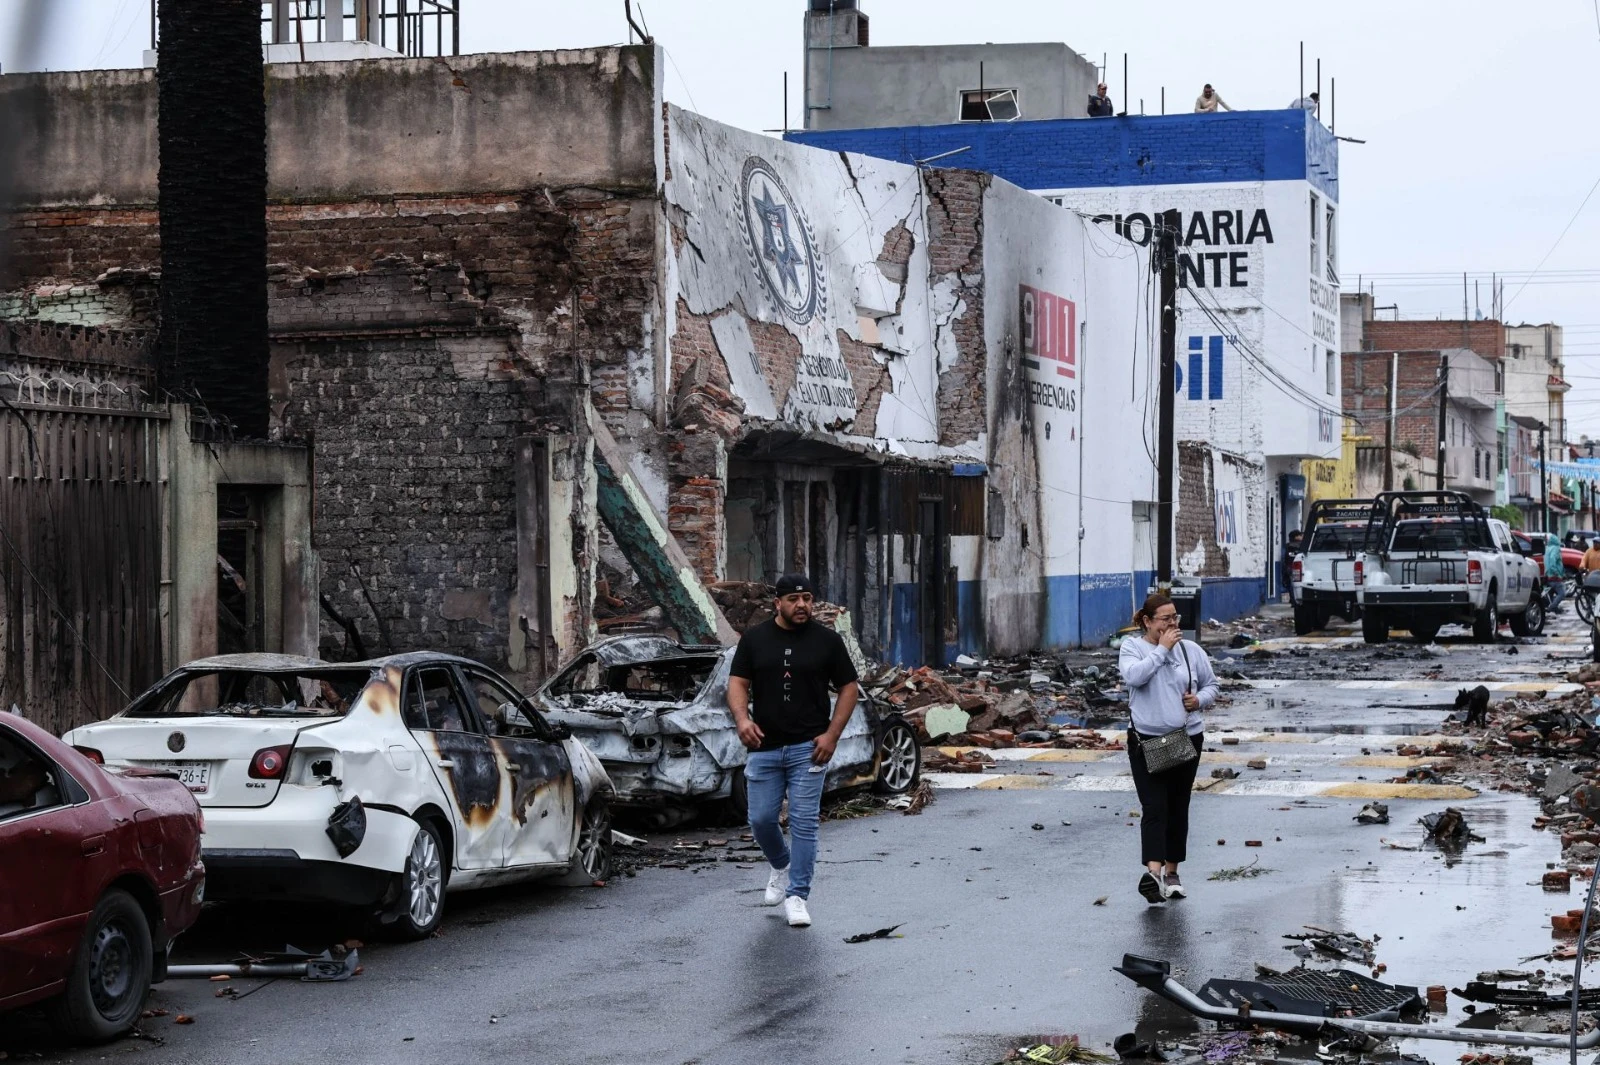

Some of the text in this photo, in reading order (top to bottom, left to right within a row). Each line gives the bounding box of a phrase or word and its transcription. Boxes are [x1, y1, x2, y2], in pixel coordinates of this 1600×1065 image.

[1092, 209, 1274, 247] IOARIA
[1024, 292, 1069, 357] 911
[1175, 336, 1223, 400] il
